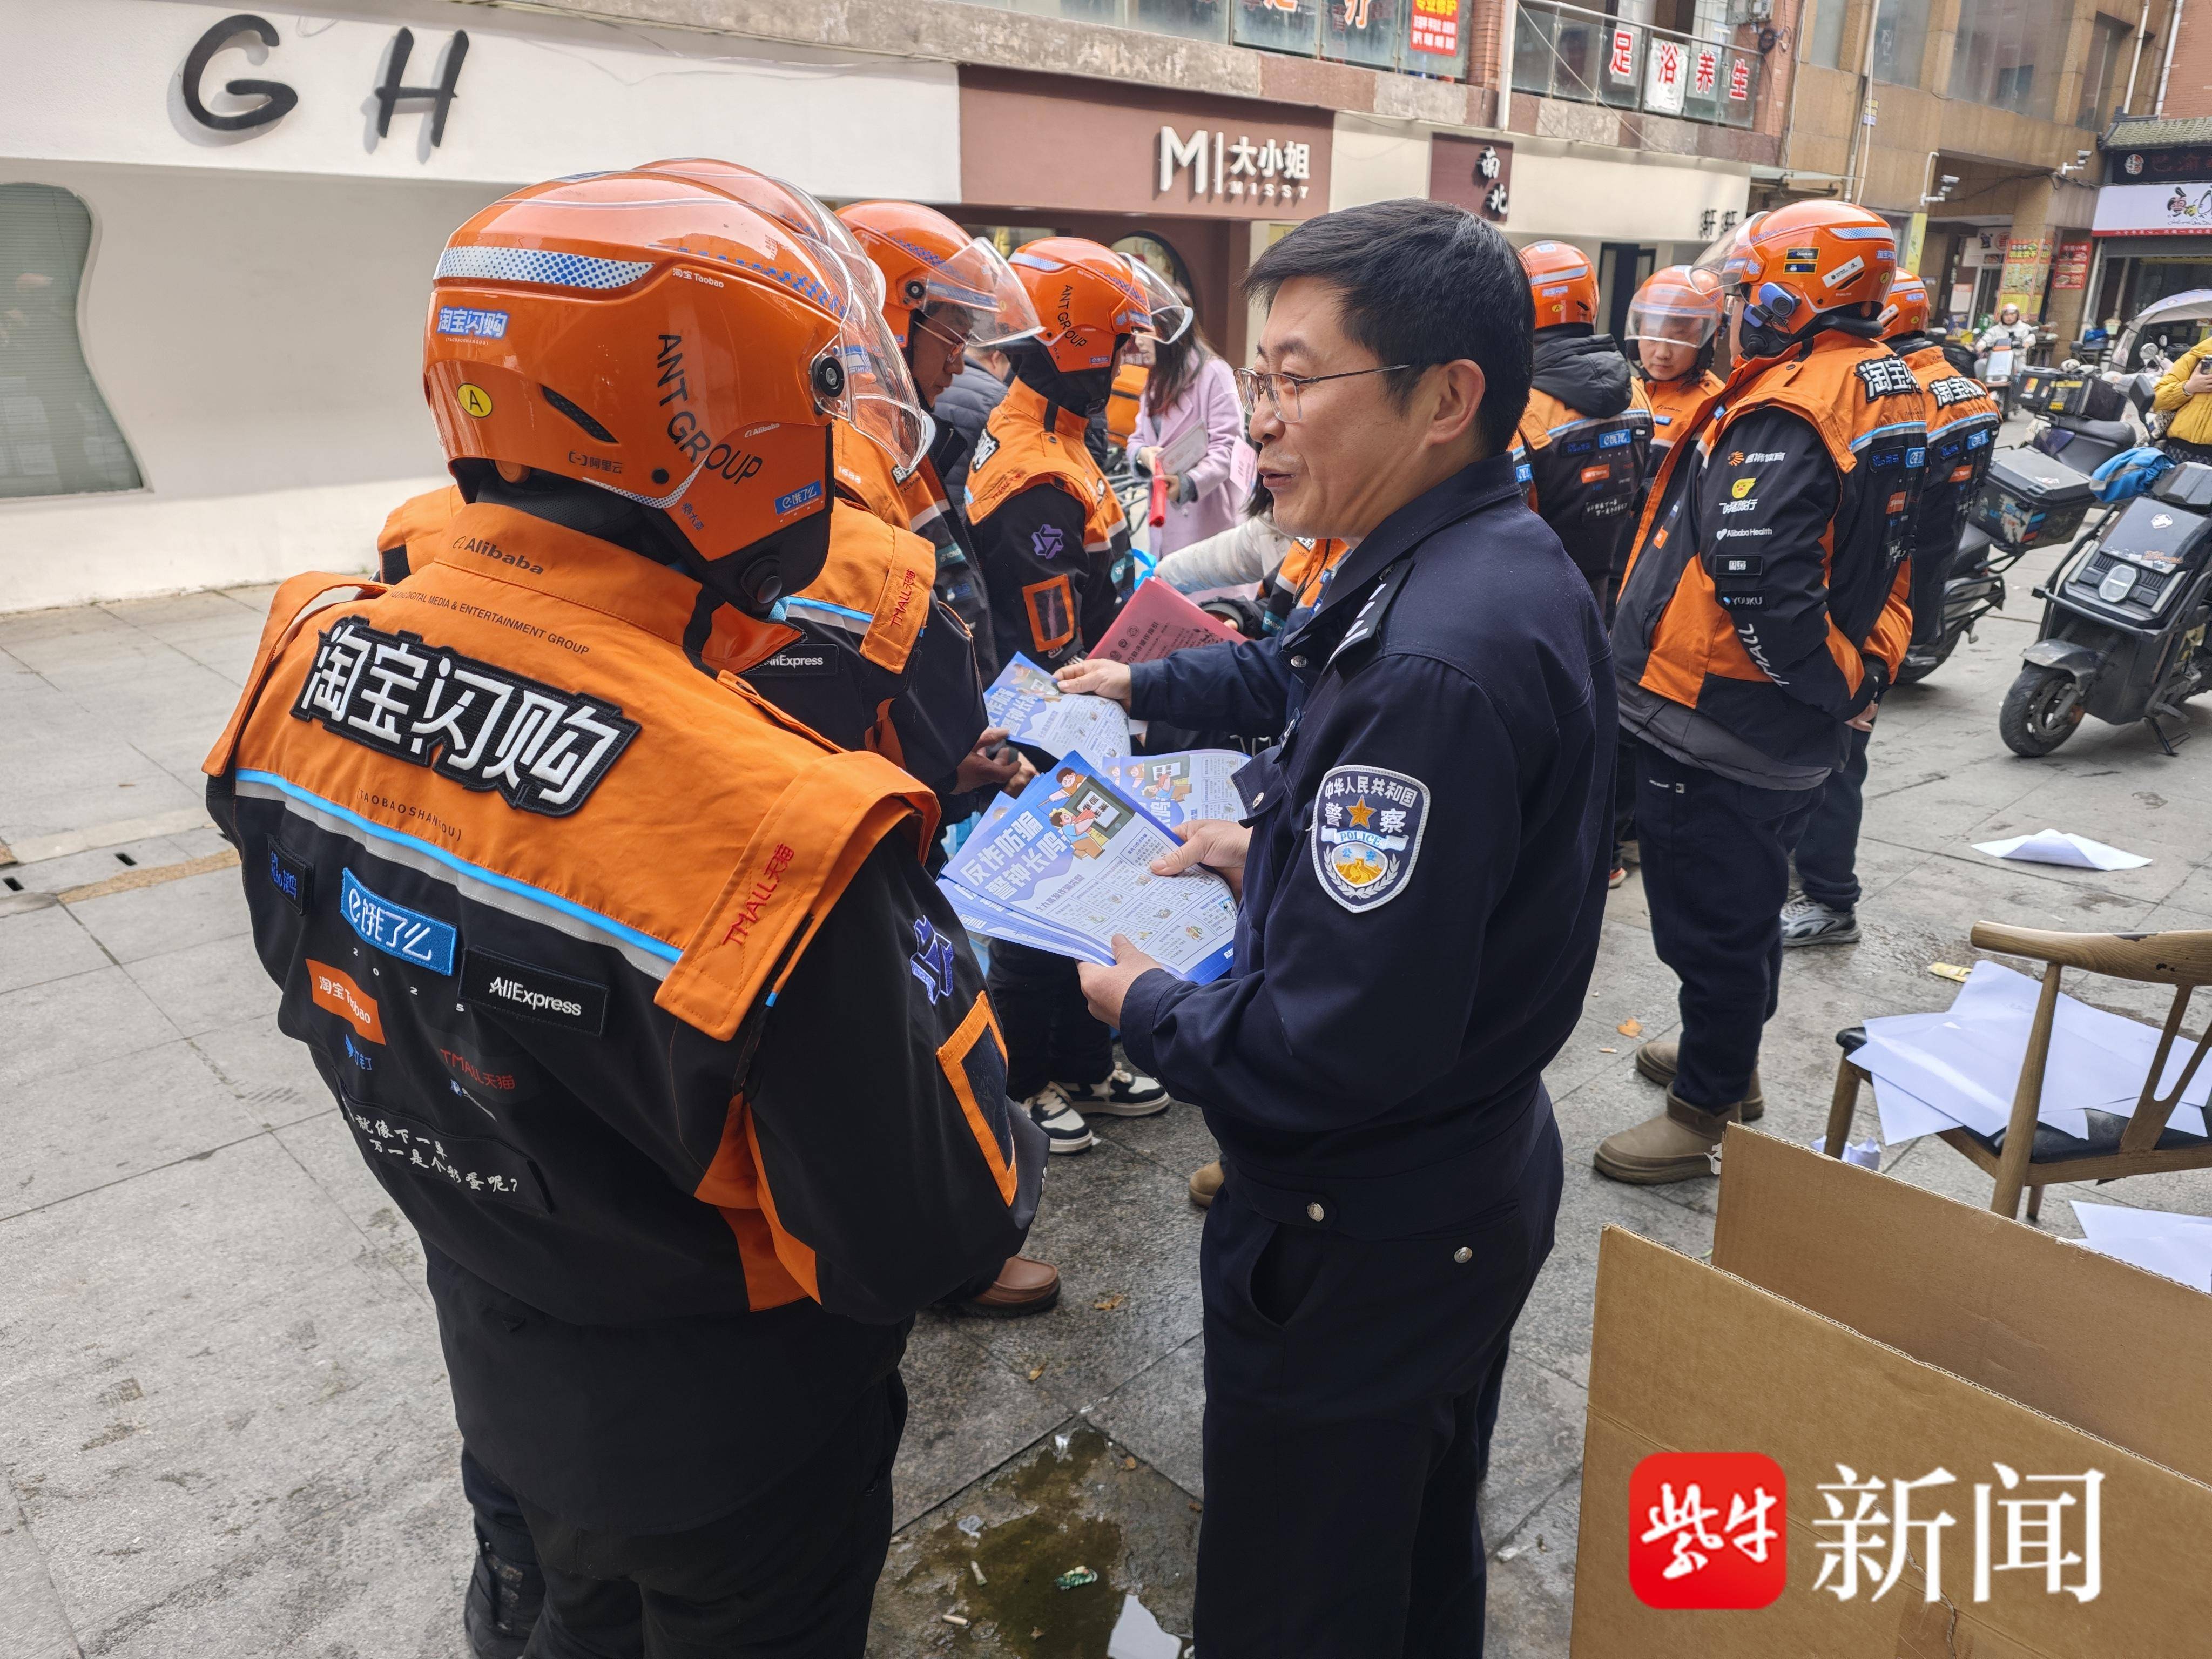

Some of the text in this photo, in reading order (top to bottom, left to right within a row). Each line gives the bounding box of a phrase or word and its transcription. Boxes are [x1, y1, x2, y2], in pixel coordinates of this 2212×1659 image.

[1227, 136, 1310, 179] 大小姐
[1229, 181, 1310, 199] MISSY
[673, 268, 724, 288] 淘宝 Taobao
[438, 308, 509, 339] 淘宝闪购
[1057, 285, 1087, 347] ANT GROUP
[469, 389, 483, 413] A
[657, 334, 763, 485] ANT GROUP
[753, 423, 780, 436] Alibaba
[589, 457, 623, 474] 阿里云
[838, 464, 862, 485] 1688
[1750, 528, 1773, 536] Health
[463, 538, 544, 575] Alibaba
[892, 569, 916, 628] TMALL天猫
[1732, 596, 1763, 605] YOUKU
[429, 595, 450, 609] MEDIA
[451, 602, 457, 610] &
[459, 603, 547, 639] ENTERTAINMENT
[547, 633, 590, 656] GROUP
[764, 655, 824, 669] liExpress
[303, 624, 621, 805] 淘宝闪购
[1325, 775, 1418, 808] 中华人民共和国
[960, 810, 1044, 887] 反诈防骗
[1340, 830, 1381, 847] POLICE
[984, 831, 1068, 901] 警钟长鸣
[722, 843, 794, 946] TMALL天猫
[1035, 873, 1086, 912] 十大高发诈骗类型
[319, 975, 371, 1024] 淘宝 Taobao
[489, 976, 582, 1017] AliExpress
[440, 1048, 516, 1090] TMALL天猫
